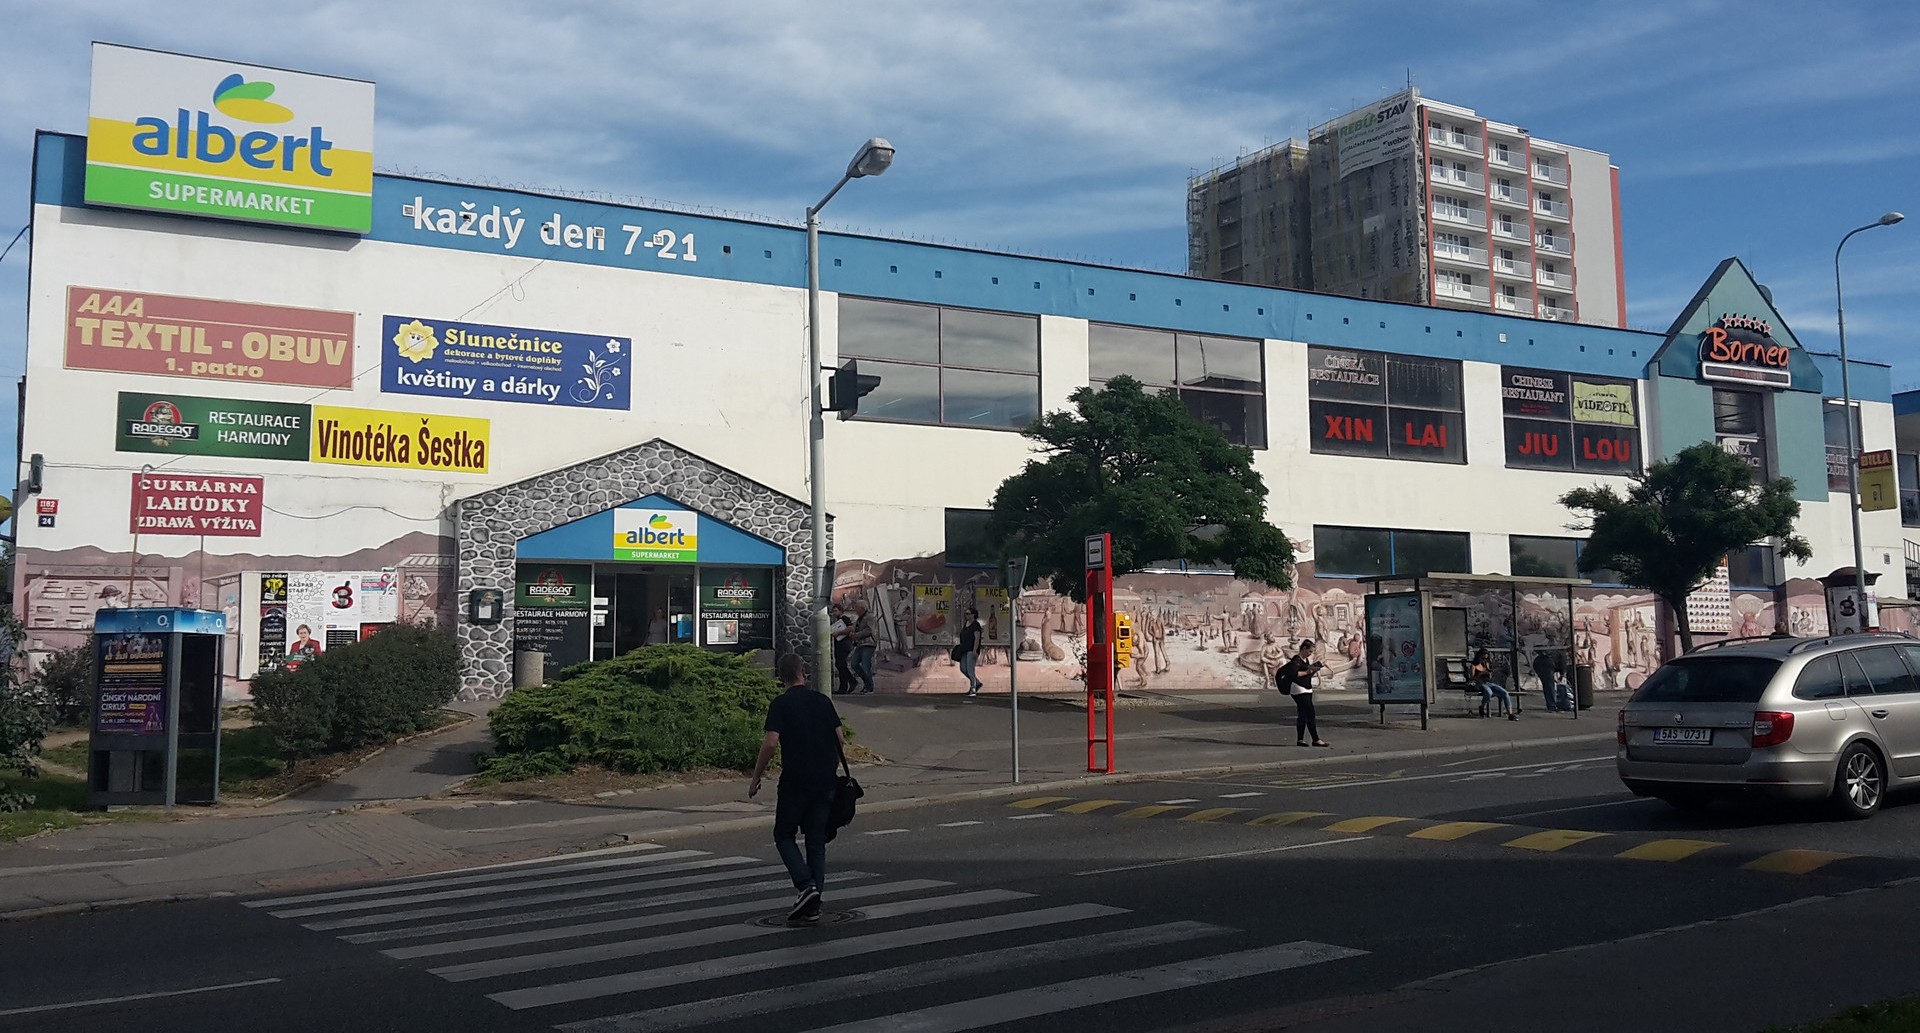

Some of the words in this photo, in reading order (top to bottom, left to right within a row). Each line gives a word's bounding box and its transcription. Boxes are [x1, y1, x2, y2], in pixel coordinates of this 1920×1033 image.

[132, 107, 333, 176] albert
[149, 181, 315, 216] SUPERMARKET
[414, 196, 526, 249] každý
[540, 213, 606, 251] den
[622, 225, 697, 262] 7-21
[77, 293, 144, 318] AAA
[75, 318, 213, 355] TEXTIL
[241, 331, 348, 366] OBUV
[444, 328, 563, 354] Slunečnice
[1706, 327, 1790, 366] Borneo
[444, 349, 486, 359] dekorace
[495, 353, 524, 362] bytové
[526, 355, 562, 366] doplňky
[164, 358, 184, 373] 1.
[191, 361, 264, 378] patro
[397, 366, 477, 396] květiny
[482, 378, 496, 392] a
[501, 376, 562, 402] dárky
[1310, 369, 1380, 386] RESTAURACE
[1512, 375, 1554, 390] CHINESE
[1502, 387, 1565, 404] RESTAURANT
[208, 411, 301, 430] RESTAURACE
[131, 423, 195, 439] RADEGAST
[217, 430, 292, 447] HARMONY
[1324, 414, 1374, 442] XIN
[1405, 422, 1447, 448] LAI
[318, 418, 410, 465] Vinotéka
[417, 418, 486, 469] Šestka
[1518, 432, 1559, 457] JIU
[1583, 436, 1631, 462] LOU
[1860, 453, 1890, 466] BILLA
[138, 479, 258, 495] CUKRÁRNA
[146, 495, 251, 513] LAHŮDKY
[135, 514, 196, 529] ZDRAVÁ
[200, 515, 257, 531] VÝŽIVA
[626, 525, 685, 546] albert
[631, 551, 680, 560] SUPERMARKET
[529, 585, 574, 596] RADEGAST
[717, 589, 757, 599] RADEGAST
[924, 586, 943, 596] AKCE
[985, 588, 1003, 598] AKCE
[513, 610, 554, 618] RESTAURACE
[555, 610, 588, 618] HARMONY
[101, 692, 127, 702] ČÍNSKÝ
[128, 692, 161, 701] NÁRODNÍ
[101, 703, 126, 711] CIRKUS
[1662, 728, 1678, 739] 5AS
[1684, 729, 1706, 740] 0731
